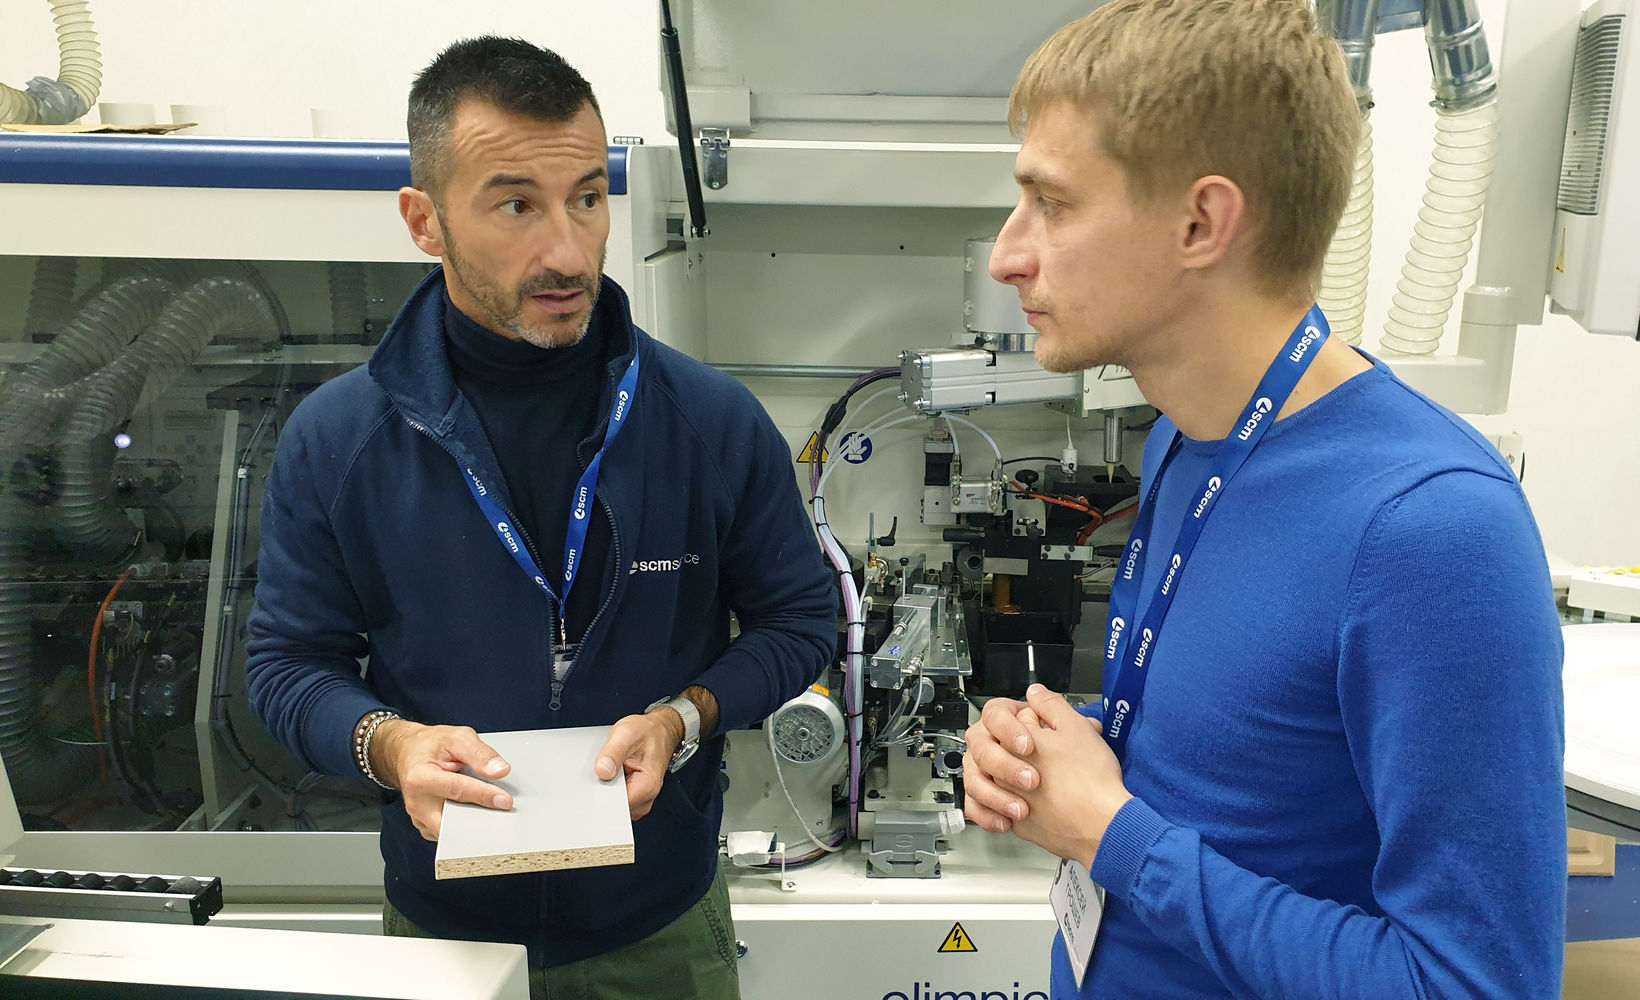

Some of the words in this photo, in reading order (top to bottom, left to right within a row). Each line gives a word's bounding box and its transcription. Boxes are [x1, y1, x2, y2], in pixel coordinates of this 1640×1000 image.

[1289, 336, 1312, 362] scm
[615, 400, 626, 421] scm
[1238, 411, 1263, 440] scm
[578, 486, 588, 508] scm
[1194, 489, 1213, 518] scm
[504, 532, 519, 553] scm
[567, 549, 576, 571] scm
[1123, 551, 1138, 579] scm
[1162, 567, 1175, 595] scm
[1107, 630, 1120, 659] scm
[1134, 640, 1149, 667] scm
[1109, 712, 1125, 738] scm
